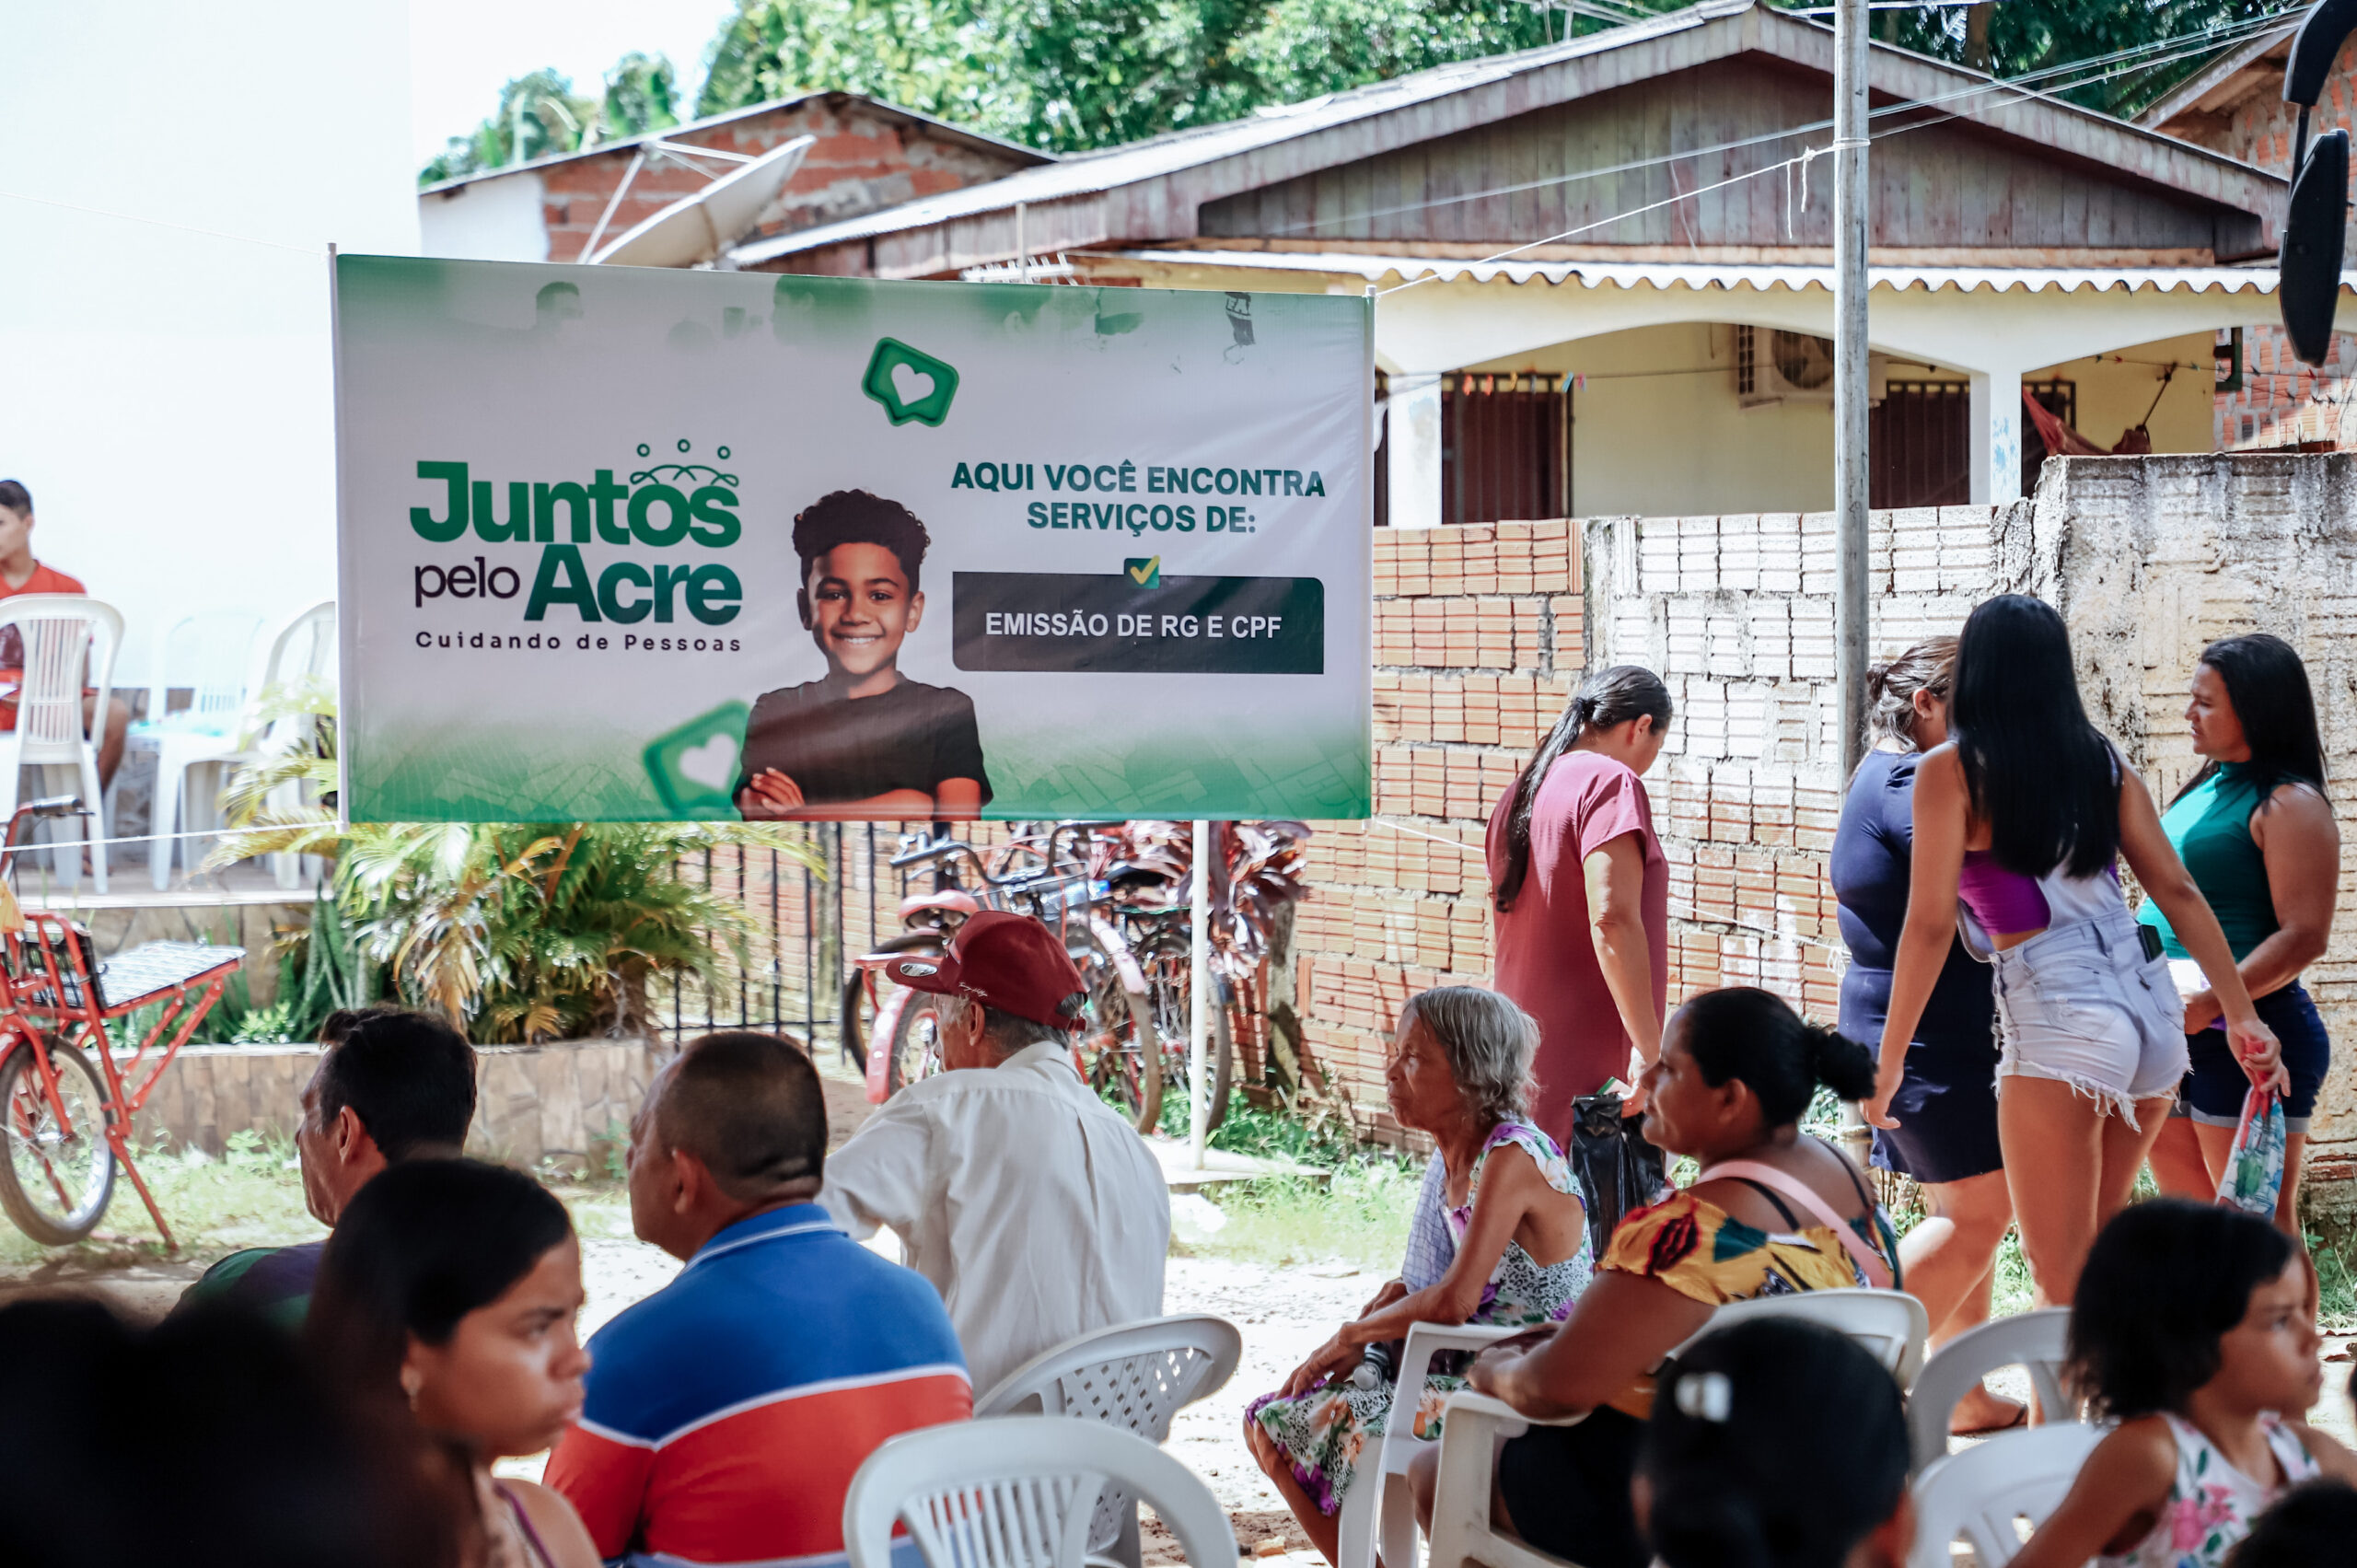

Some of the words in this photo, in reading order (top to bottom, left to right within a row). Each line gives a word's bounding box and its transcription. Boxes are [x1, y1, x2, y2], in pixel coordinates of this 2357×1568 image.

[951, 461, 1033, 493] AQUI
[1044, 459, 1137, 493] VOCÊ
[1147, 467, 1326, 497] ENCONTRA
[410, 459, 742, 549] Juntos
[1028, 502, 1196, 538] SERVIÇOS
[1206, 505, 1256, 533] DE:
[414, 556, 521, 609] pelo
[524, 543, 743, 626] Acre
[415, 631, 561, 650] Cuidando
[576, 633, 609, 650] de
[624, 633, 740, 652] Pessoas
[985, 609, 1109, 637] EMISSÃO
[1117, 614, 1153, 637] DE
[1161, 615, 1199, 638] RG
[1207, 616, 1224, 638] E
[1231, 616, 1283, 638] CPF
